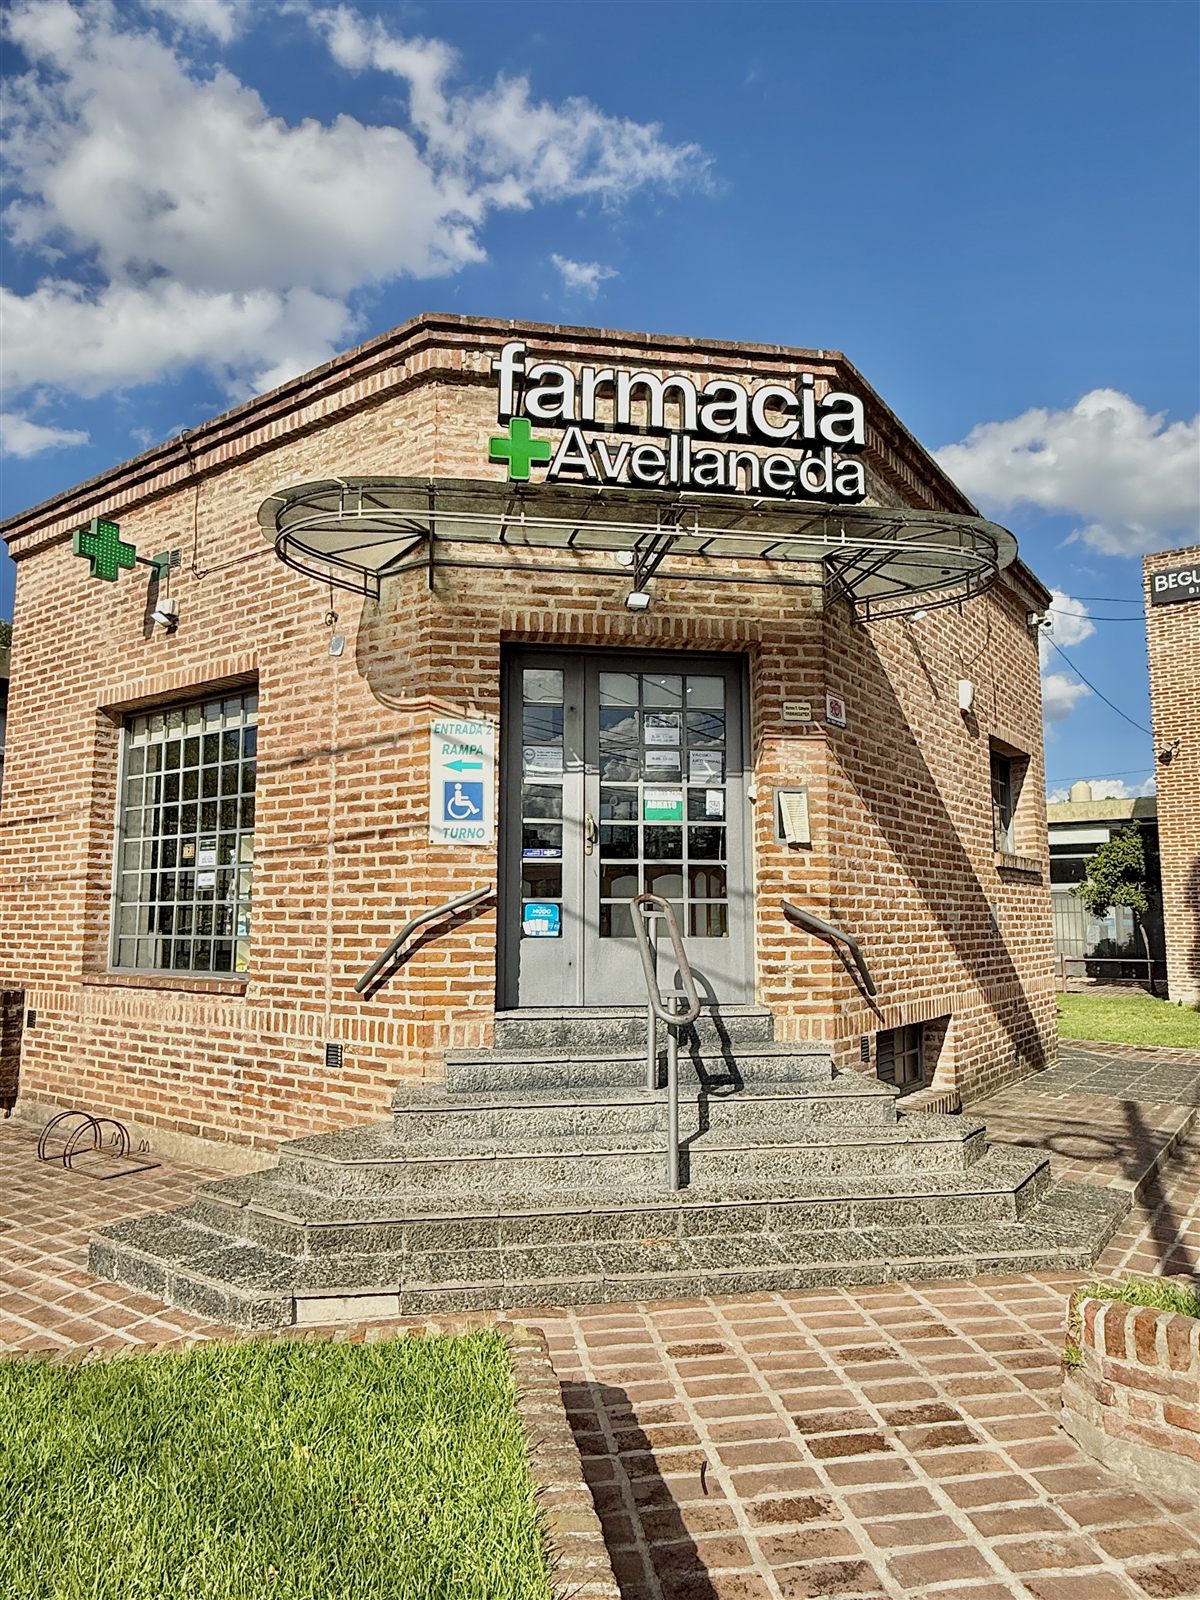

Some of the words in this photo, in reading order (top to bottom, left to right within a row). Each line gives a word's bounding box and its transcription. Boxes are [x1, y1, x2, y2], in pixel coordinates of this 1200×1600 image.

[491, 341, 866, 446] farmacia
[549, 426, 867, 496] Avellaneda
[433, 723, 483, 735] ENTRADA
[485, 724, 492, 735] 2
[441, 743, 484, 756] RAMPA
[443, 827, 485, 839] TURNO
